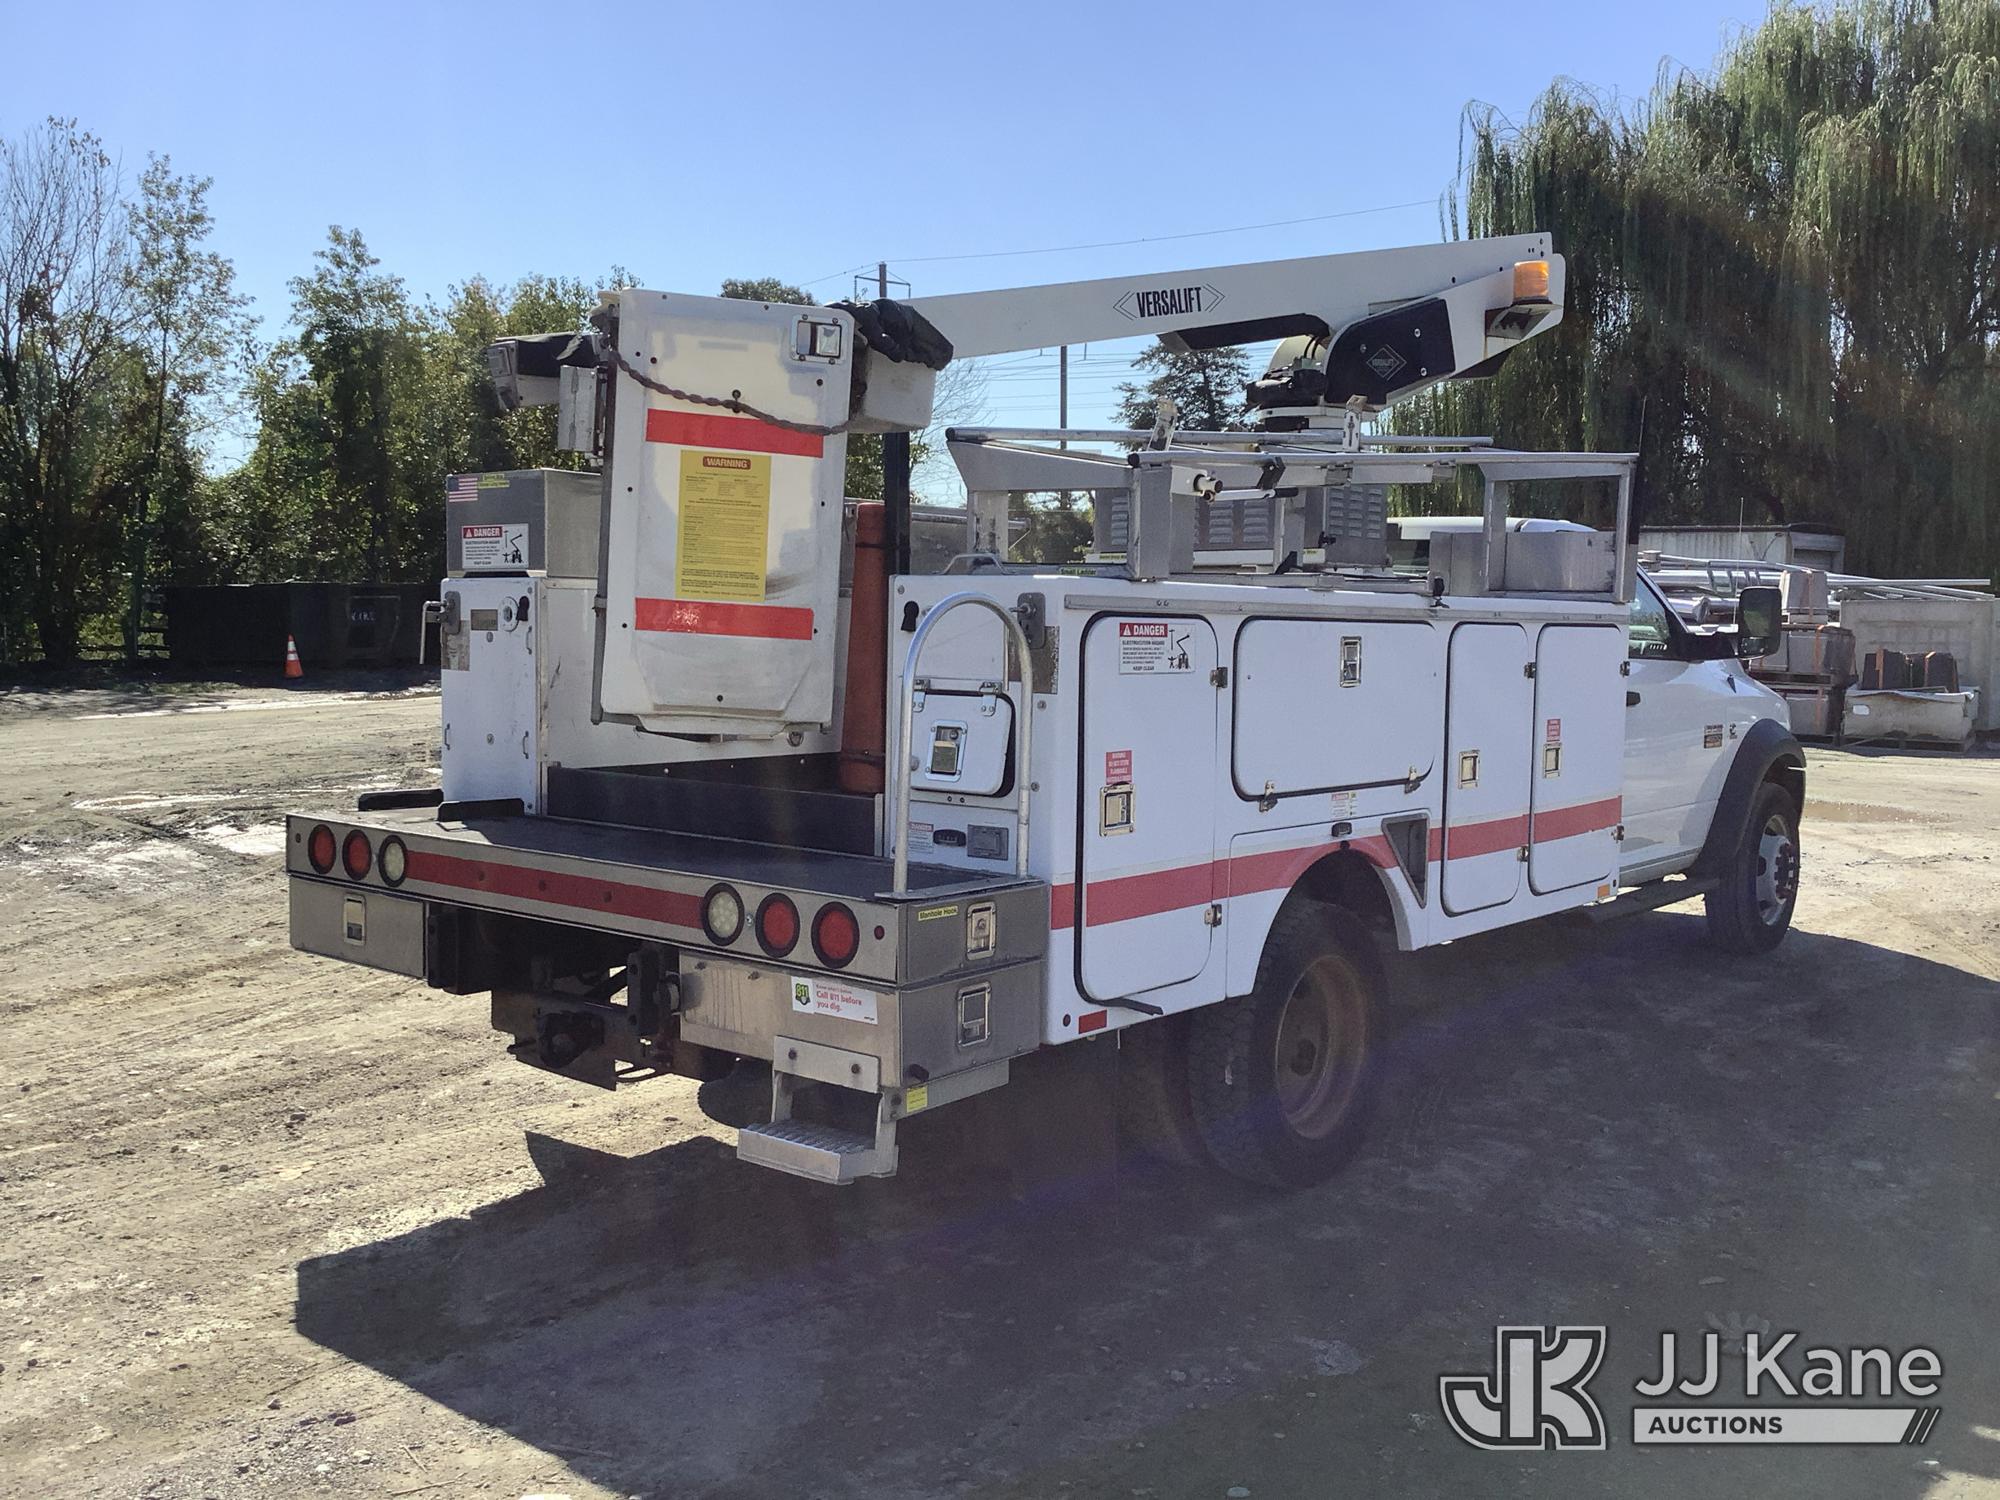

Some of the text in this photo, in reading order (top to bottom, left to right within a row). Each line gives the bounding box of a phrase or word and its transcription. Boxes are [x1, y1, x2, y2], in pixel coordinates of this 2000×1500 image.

[1137, 287, 1201, 317] VERSALIFT
[706, 457, 748, 468] WARNING
[474, 528, 500, 537] DANGER
[1133, 624, 1165, 635] DANGER
[795, 983, 809, 998] 811
[816, 990, 829, 999] Call
[840, 994, 862, 1006] before
